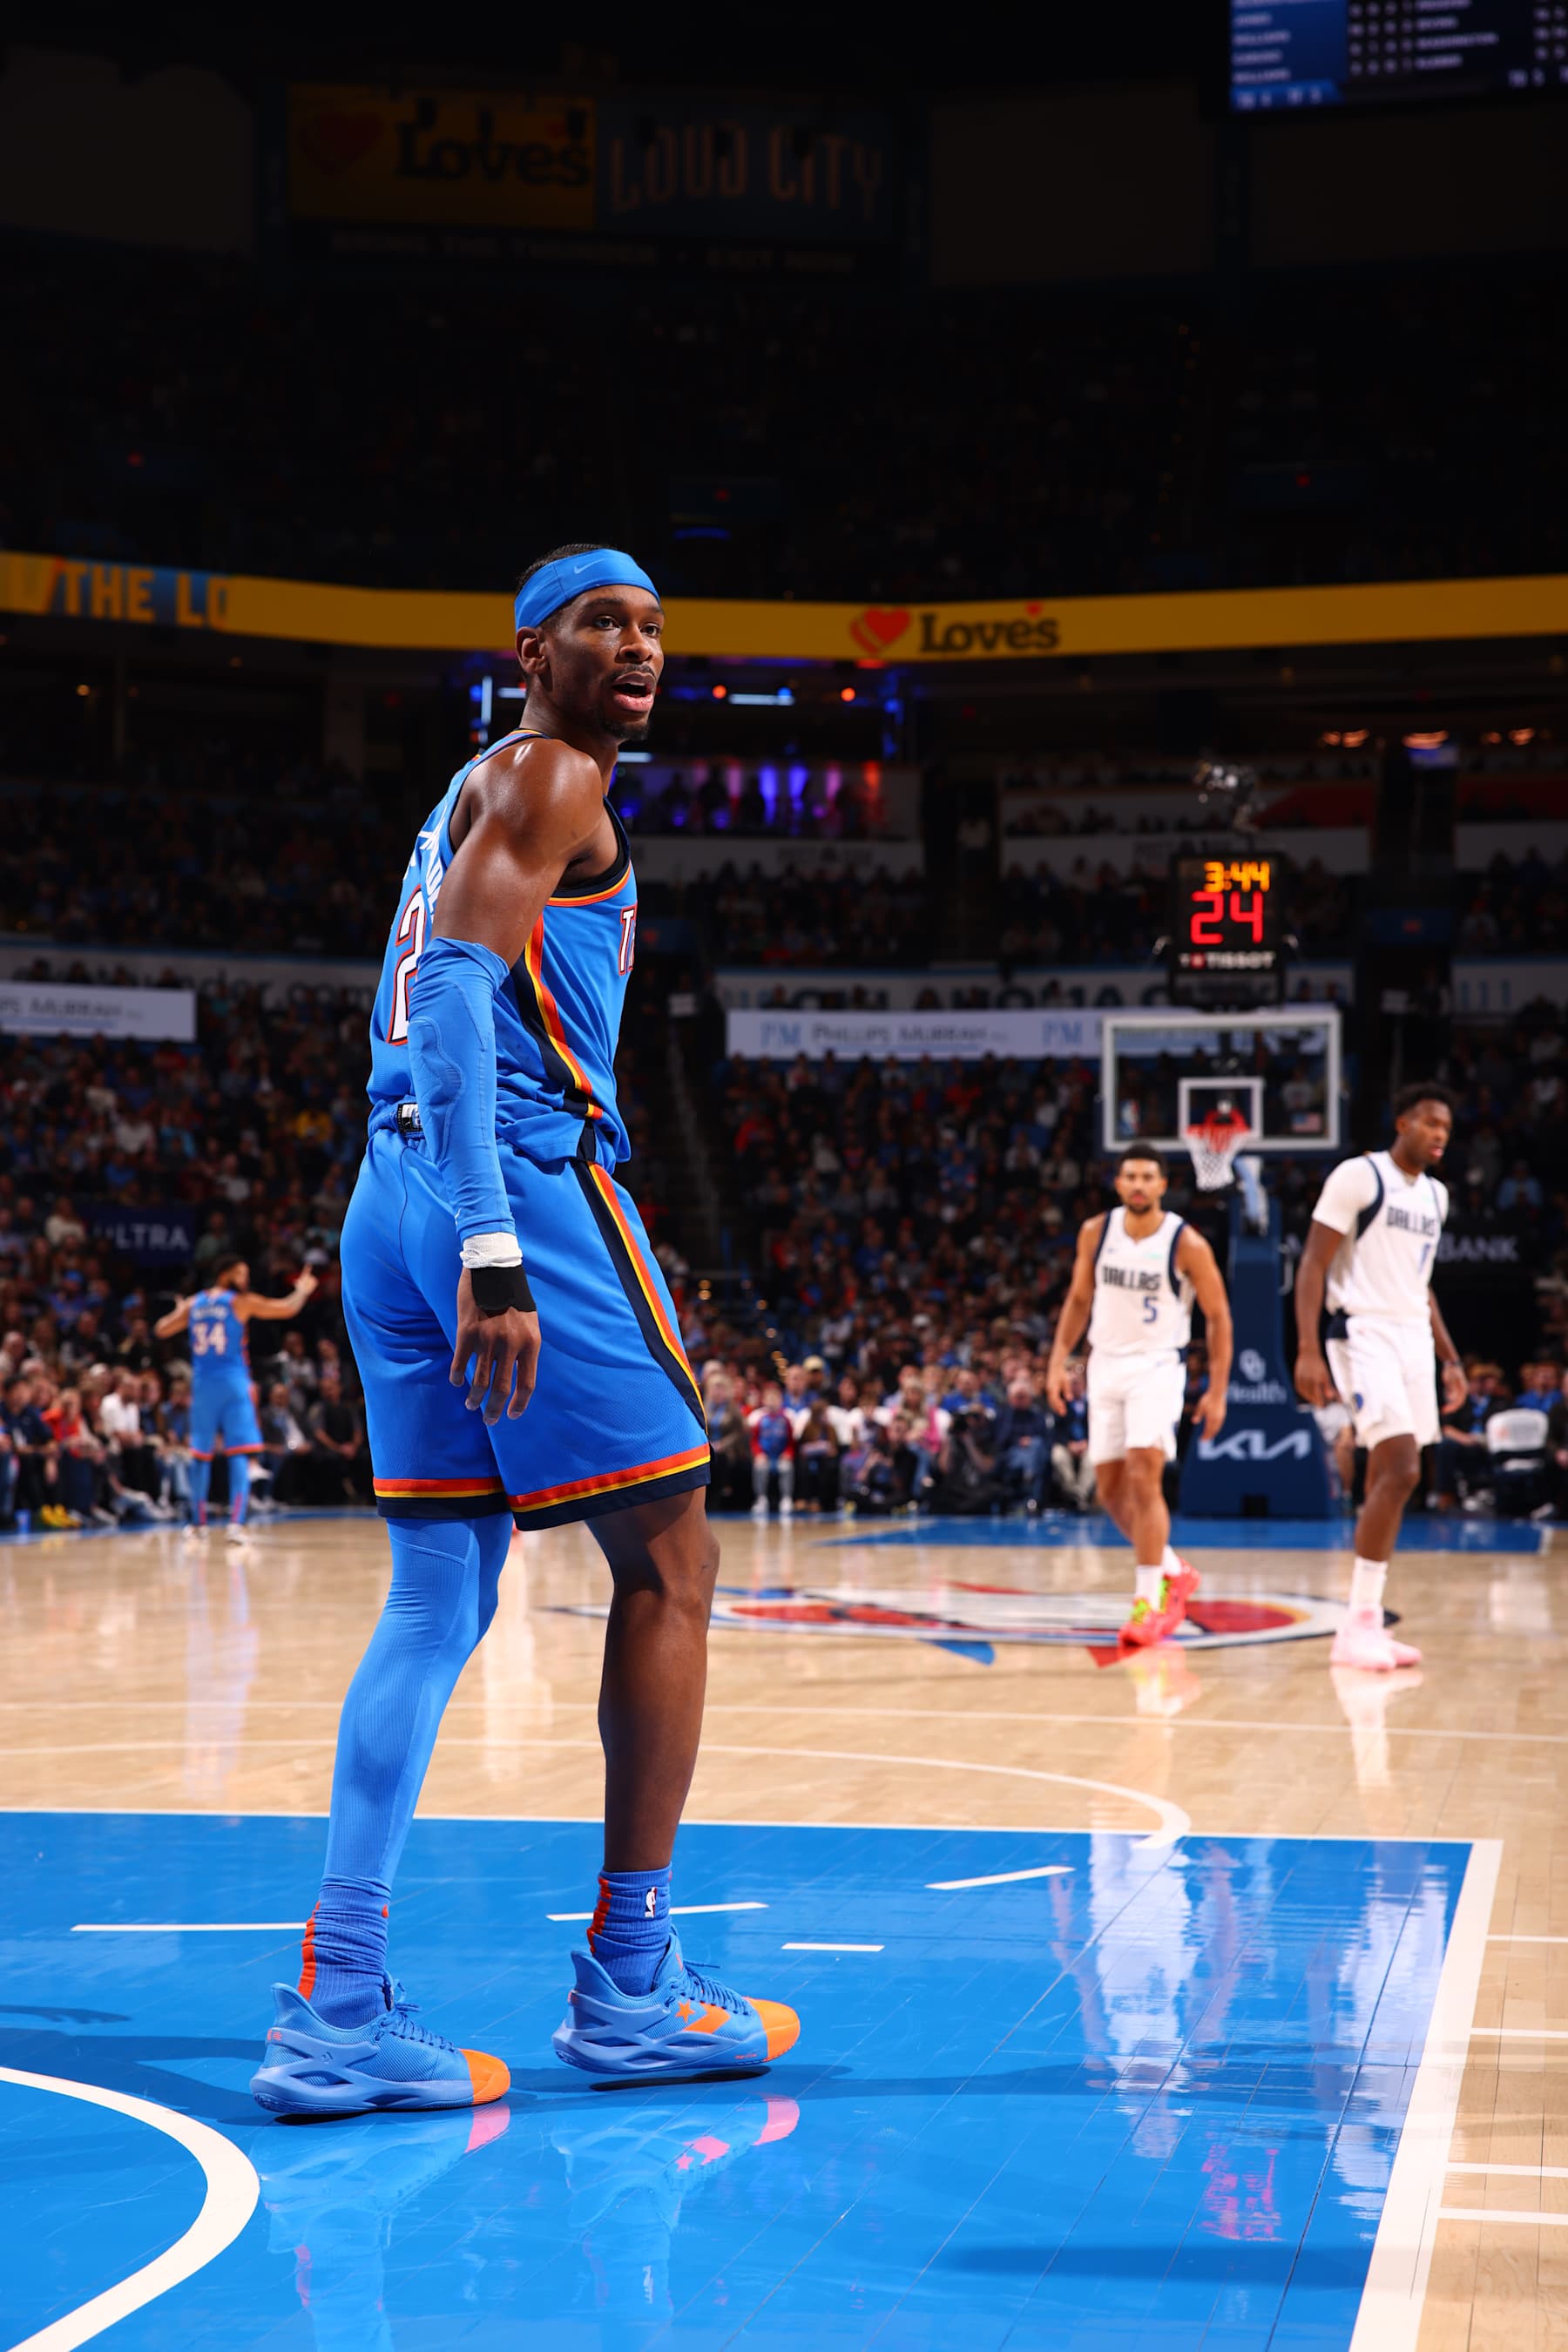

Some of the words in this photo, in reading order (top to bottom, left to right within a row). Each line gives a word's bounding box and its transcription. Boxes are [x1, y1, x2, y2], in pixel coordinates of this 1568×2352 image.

[1203, 861, 1270, 893] 3:44
[1190, 890, 1263, 944] 24
[1102, 1265, 1161, 1291] DALLAS
[1143, 1296, 1158, 1323] 5
[192, 1322, 227, 1356] 34
